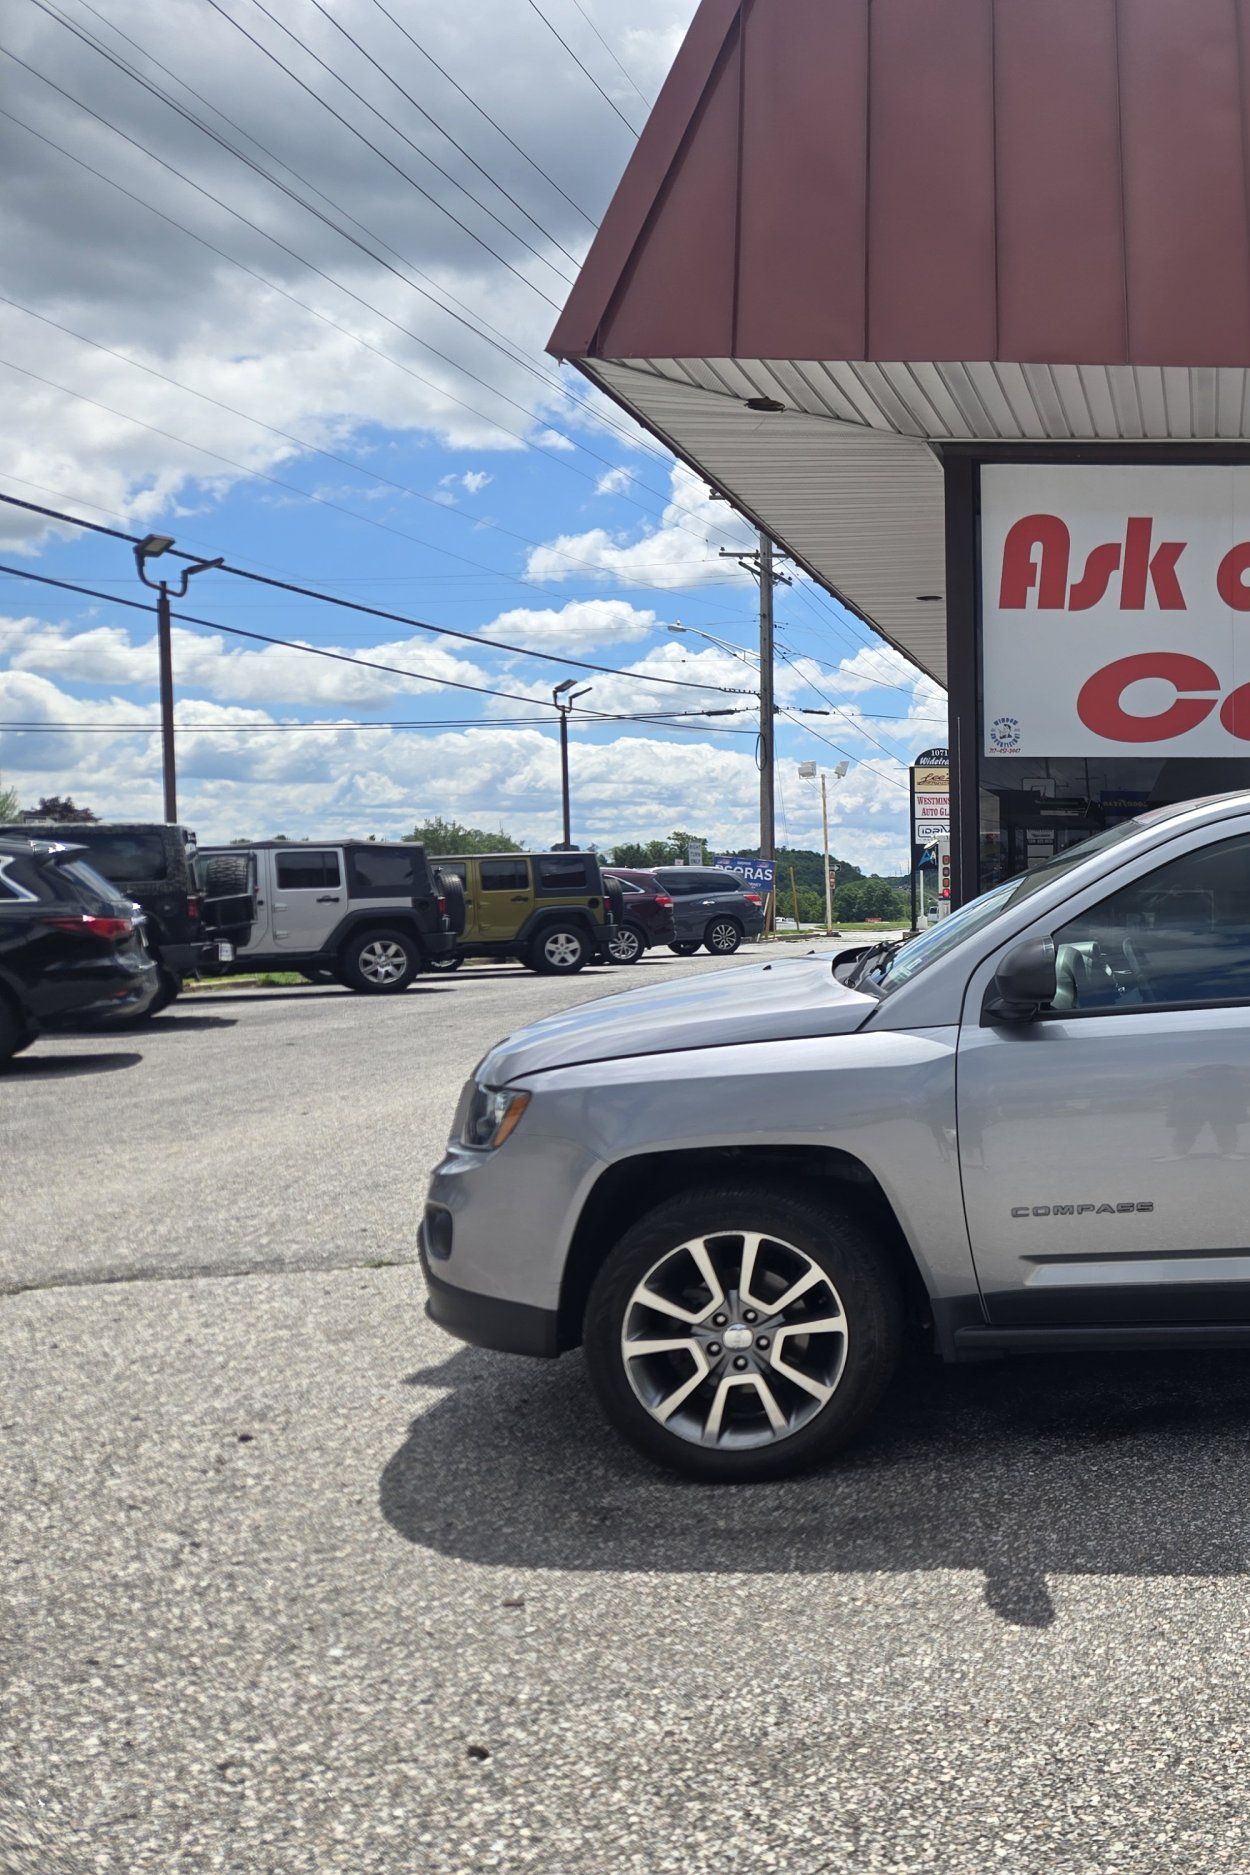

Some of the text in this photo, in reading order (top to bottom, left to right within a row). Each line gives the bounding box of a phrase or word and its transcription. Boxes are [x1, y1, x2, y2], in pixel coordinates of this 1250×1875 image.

[999, 513, 1188, 612] Ask
[931, 749, 948, 757] 1071
[922, 807, 938, 816] AUTO
[1011, 1201, 1154, 1218] COMPASS
